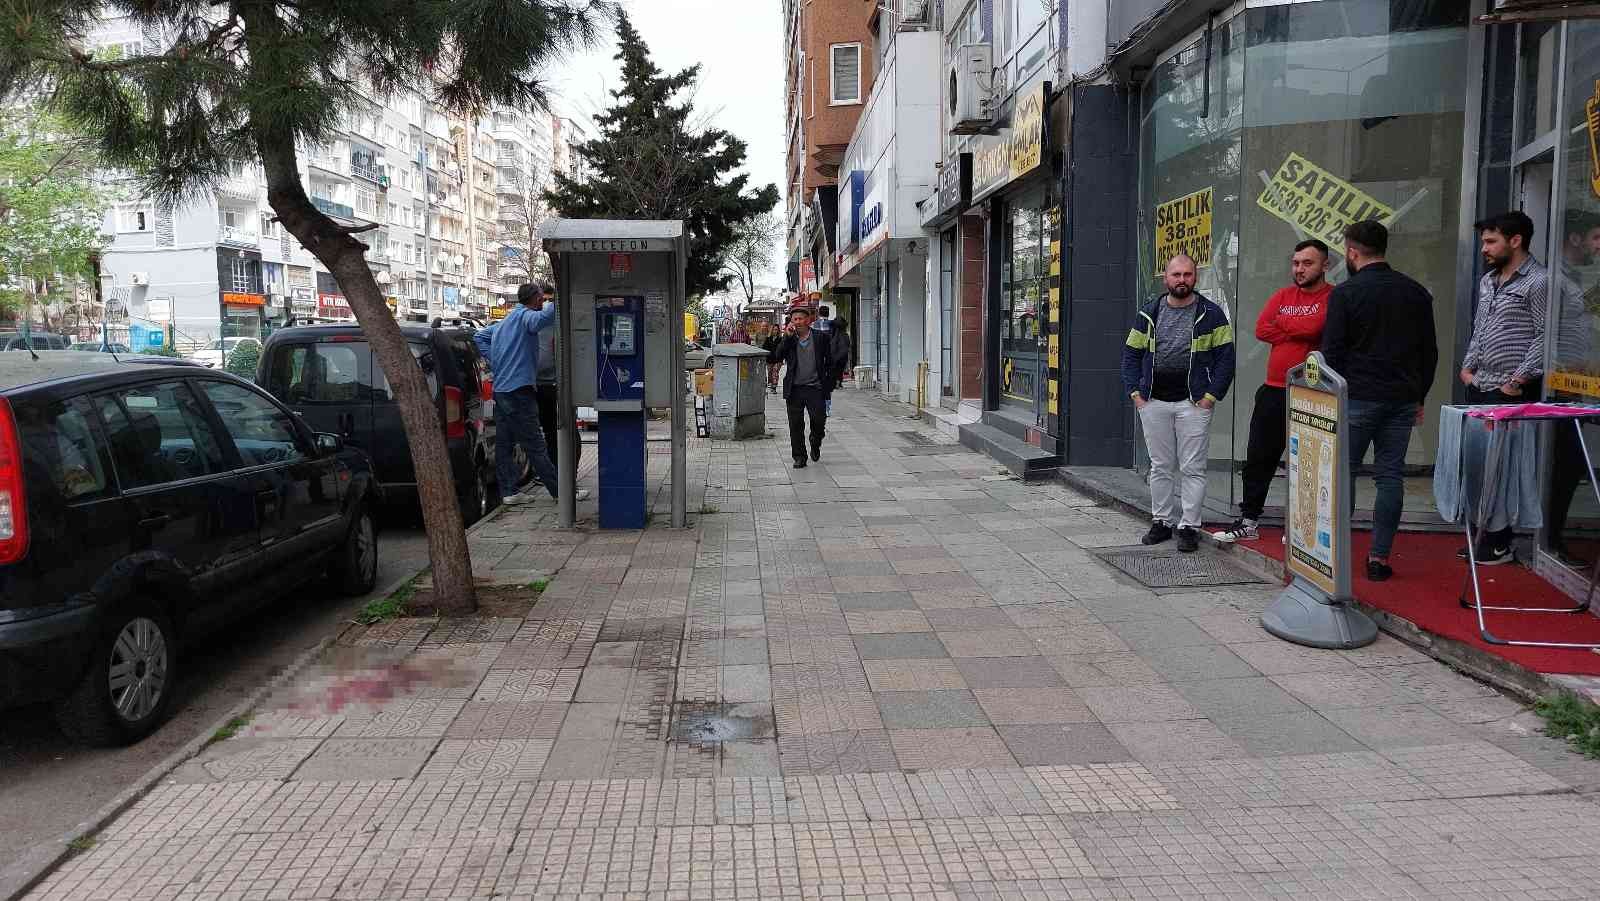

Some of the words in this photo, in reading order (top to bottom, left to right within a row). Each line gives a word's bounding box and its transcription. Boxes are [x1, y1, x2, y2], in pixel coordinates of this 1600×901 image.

[1158, 190, 1211, 227] SATILIK
[1281, 160, 1391, 222] SATILIK
[1298, 203, 1332, 234] 326
[1325, 219, 1345, 246] 25
